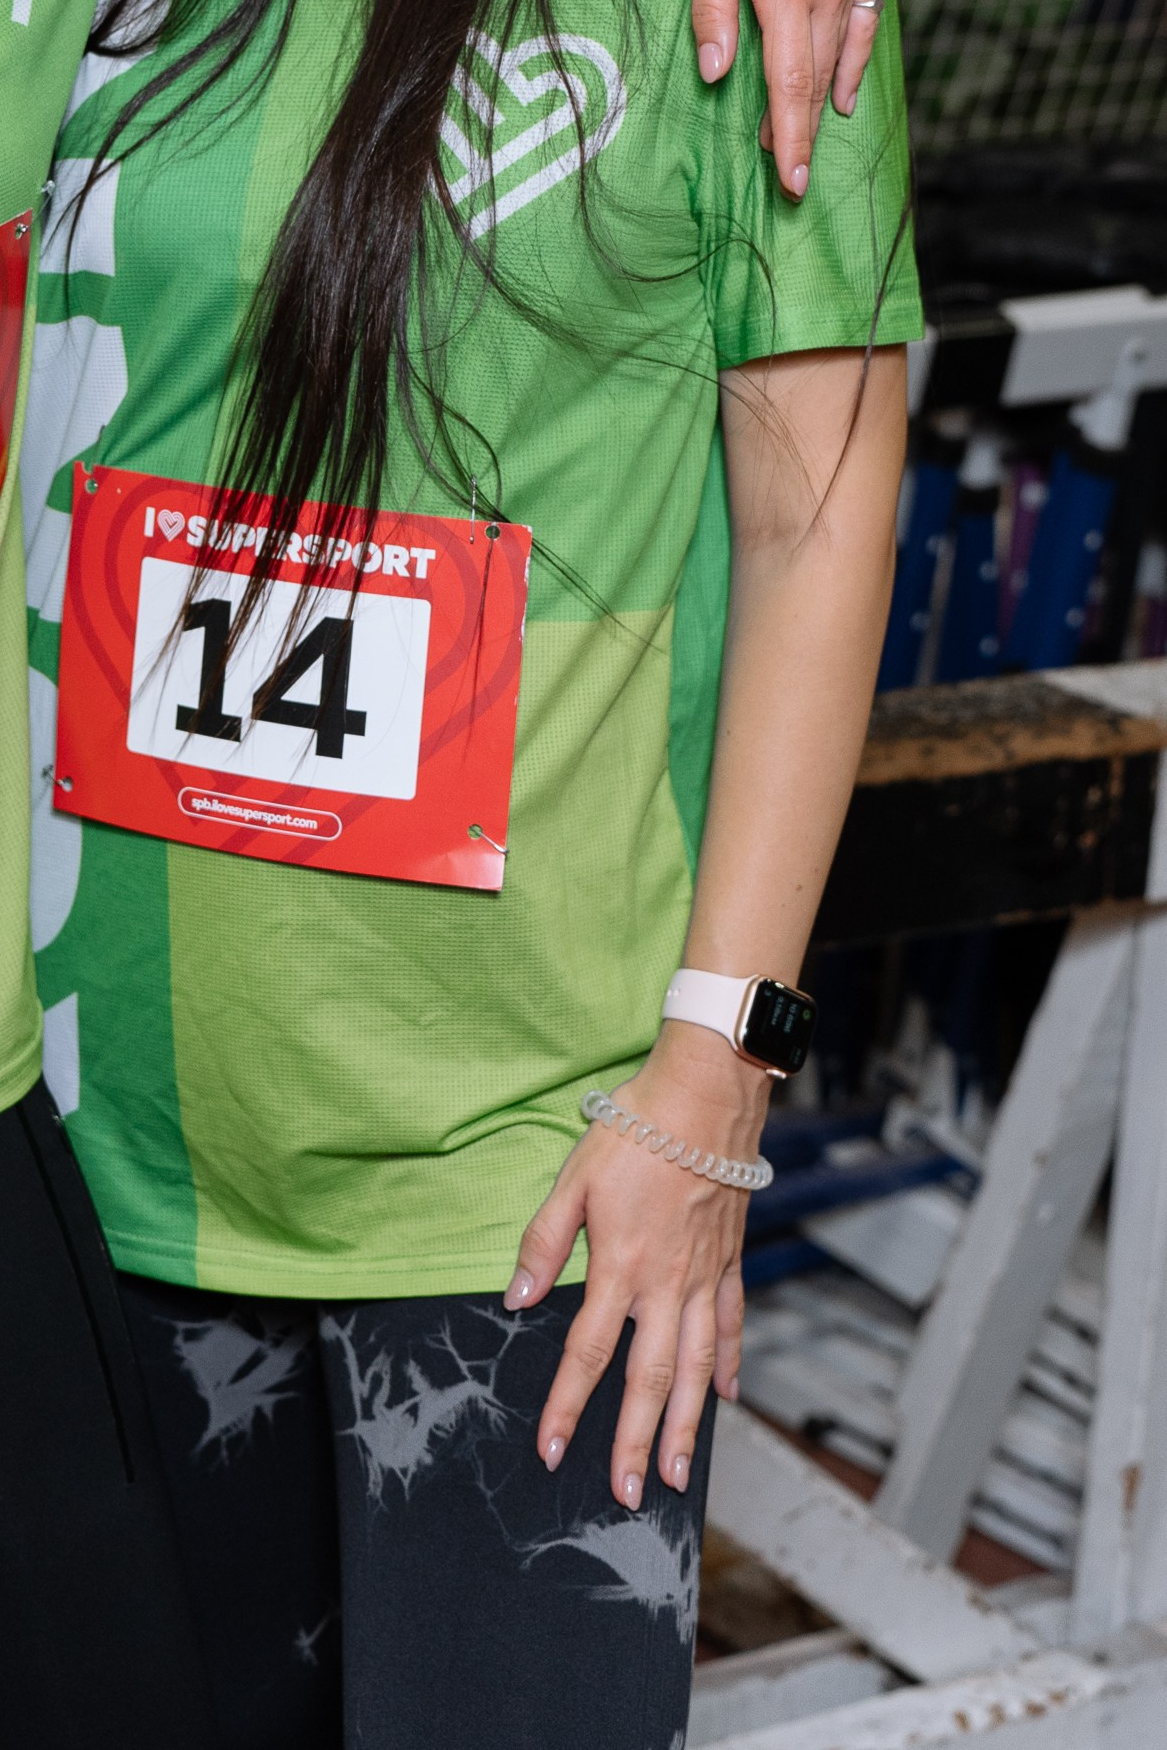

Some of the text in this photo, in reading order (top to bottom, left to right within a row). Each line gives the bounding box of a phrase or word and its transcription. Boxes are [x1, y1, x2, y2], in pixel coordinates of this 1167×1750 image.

[143, 505, 156, 538] I
[174, 596, 368, 760] 14
[190, 797, 318, 830] spb.ilovesupersport.com
